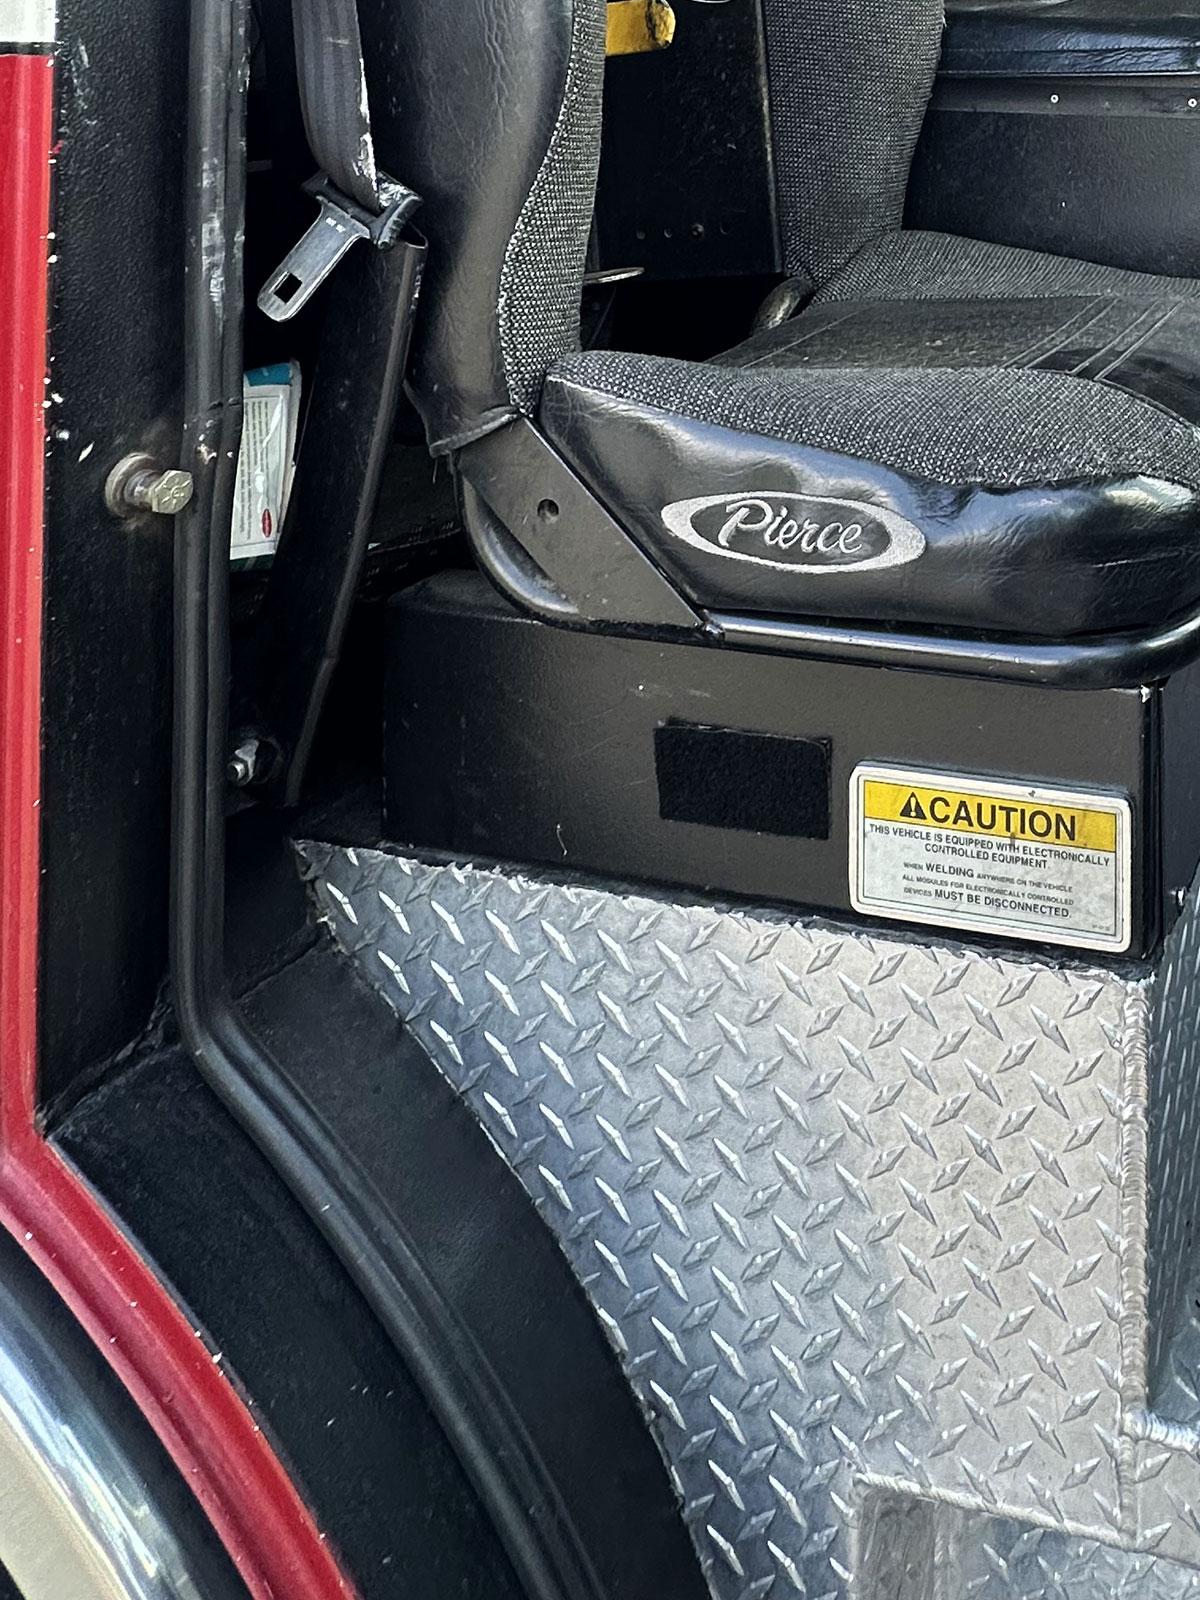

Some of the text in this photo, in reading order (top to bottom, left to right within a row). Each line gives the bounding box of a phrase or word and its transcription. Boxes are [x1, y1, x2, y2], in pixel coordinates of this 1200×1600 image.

[717, 499, 863, 554] Pierce
[929, 796, 1077, 842] CAUTION
[869, 823, 1110, 866] THIS VEHICLE IS EQUIPPED WITH ELECTRONICALLY
[924, 843, 1051, 869] CONTROLLED EQUIPMENT.
[902, 874, 914, 882] ALL
[950, 881, 964, 890] FOR
[965, 882, 1026, 899] ELECTRONICALLY
[1027, 892, 1075, 906] CONTROLLED
[903, 862, 924, 871] WHEN
[925, 862, 974, 878] WELDING
[1016, 879, 1027, 887] ON
[1028, 880, 1041, 888] THE
[1043, 881, 1073, 893] VEHICLE
[904, 886, 1072, 919] DEVICES MUST BE DISCONNECTED.
